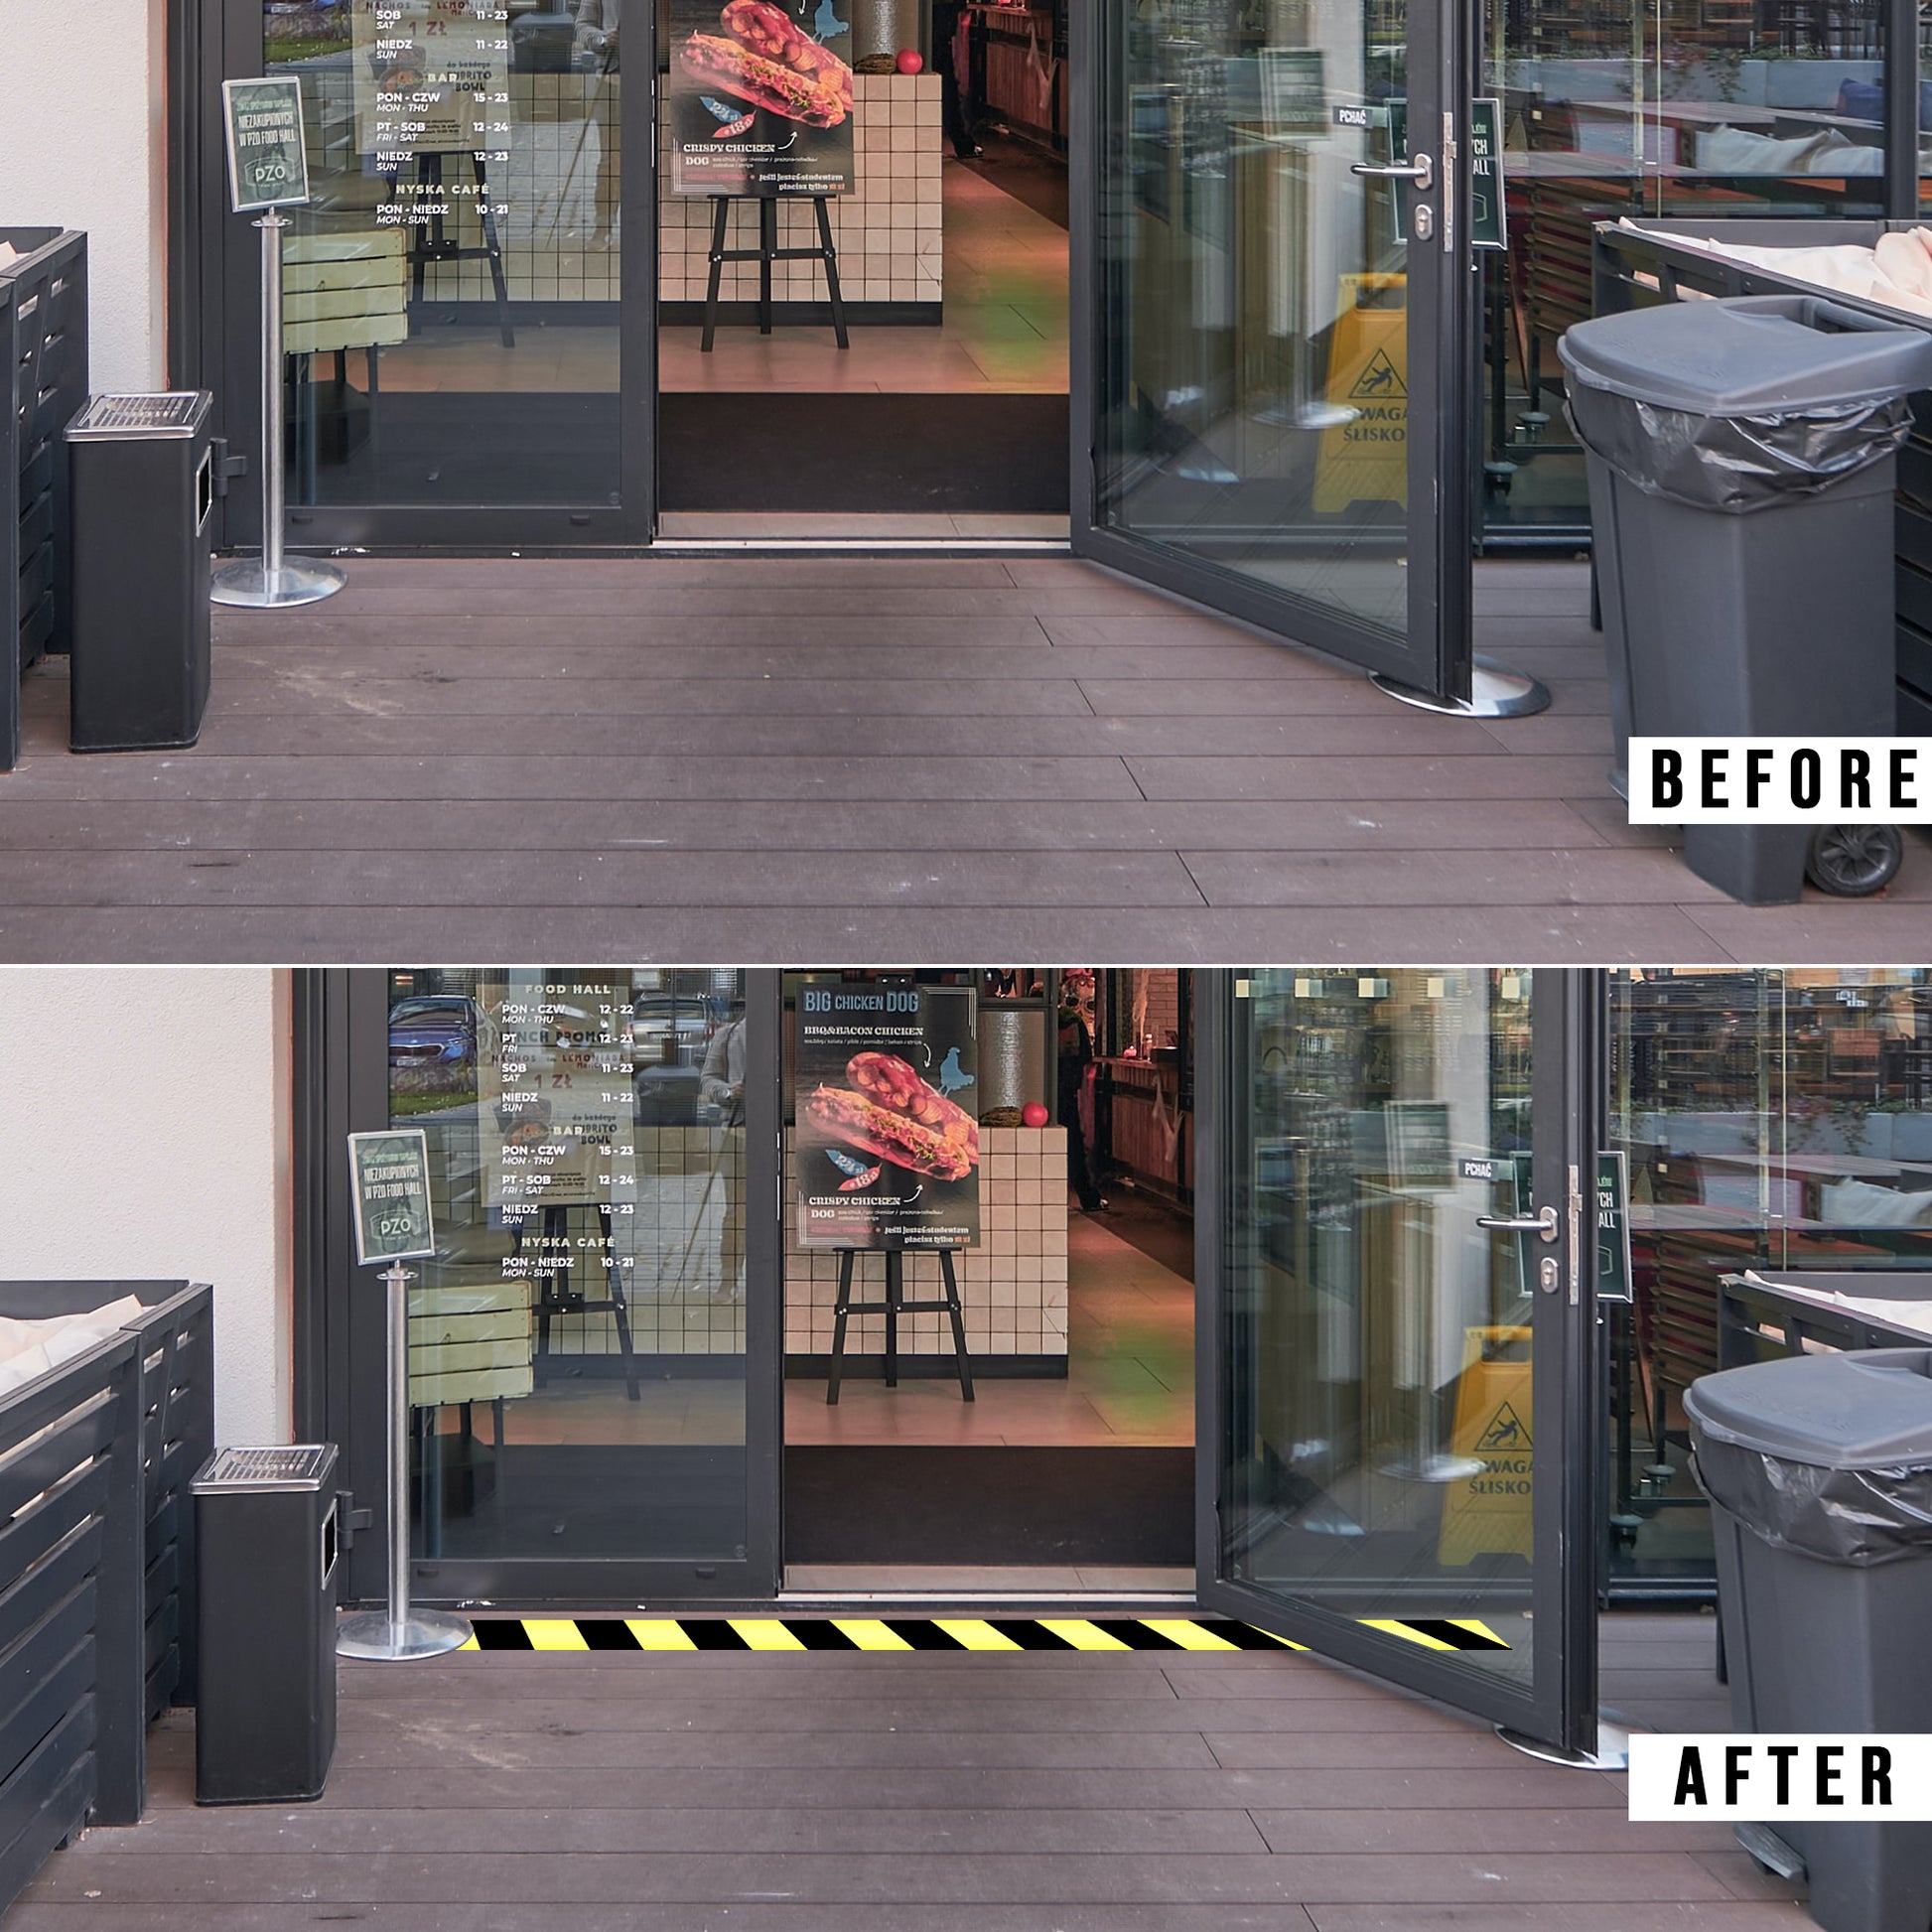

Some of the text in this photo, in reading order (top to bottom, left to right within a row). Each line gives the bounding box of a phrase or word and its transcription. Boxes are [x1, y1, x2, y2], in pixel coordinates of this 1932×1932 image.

[376, 10, 401, 20] SOB
[476, 10, 485, 20] 11
[494, 10, 508, 20] 23
[376, 40, 412, 49] NIEDZ
[476, 40, 508, 49] 11 22
[376, 50, 397, 59] SUN
[376, 92, 440, 102] PON CZW
[474, 92, 508, 102] 15 23
[376, 103, 428, 112] MON THU
[1339, 109, 1366, 124] PCHAĆ
[376, 122, 391, 131] PT
[401, 122, 426, 131] SOB
[473, 122, 508, 131] 12 24
[729, 120, 746, 134] 18
[239, 128, 296, 146] W PZO FOOD HALL
[683, 143, 774, 152] CRISPY CHICKEN
[376, 151, 413, 161] NIEDZ
[474, 151, 508, 161] 12 23
[685, 156, 709, 165] DOG
[376, 162, 397, 171] SUN
[1473, 160, 1490, 176] ALL
[255, 165, 286, 182] PZO
[396, 182, 489, 194] NYSKA CAFÉ
[376, 205, 449, 213] PON NIEDZ
[476, 205, 508, 213] 10 21
[1358, 407, 1407, 421] WAG
[1343, 423, 1405, 441] ŚLISKO
[526, 985, 612, 994] FOOD HALL
[804, 991, 918, 1012] BIG CHICKEN DOG
[502, 1005, 565, 1014] PON CZW
[600, 1005, 633, 1014] 12 22
[804, 1027, 923, 1035] BBQ&BACON CHICKEN
[500, 1031, 548, 1042] NCH
[502, 1034, 516, 1043] PT
[600, 1034, 633, 1043] 12 23
[502, 1063, 527, 1072] SOB
[602, 1063, 612, 1072] 11
[620, 1063, 633, 1072] 23
[502, 1093, 538, 1102] NIEDZ
[602, 1093, 633, 1102] 11 22
[502, 1146, 565, 1156] PON CZW
[600, 1146, 633, 1156] 15 23
[502, 1157, 554, 1166] MON THU
[1464, 1164, 1492, 1177] PCHAĆ
[502, 1175, 516, 1184] PT
[526, 1175, 551, 1184] SOB
[599, 1175, 633, 1184] 12 24
[855, 1173, 872, 1187] 18
[365, 1181, 422, 1199] W PZO FOOD HALL
[808, 1196, 900, 1205] CRISPY CHICKEN
[502, 1204, 538, 1213] NIEDZ
[600, 1204, 633, 1213] 12 23
[811, 1209, 835, 1218] DOG
[502, 1215, 522, 1224] SUN
[1598, 1213, 1615, 1229] ALL
[381, 1218, 411, 1235] PZO
[521, 1235, 616, 1247] NYSKA CAFÉ
[502, 1258, 574, 1267] PON NIEDZ
[601, 1258, 633, 1267] 10 21
[1484, 1460, 1533, 1474] WAG
[1469, 1476, 1531, 1494] ŚLISKO
